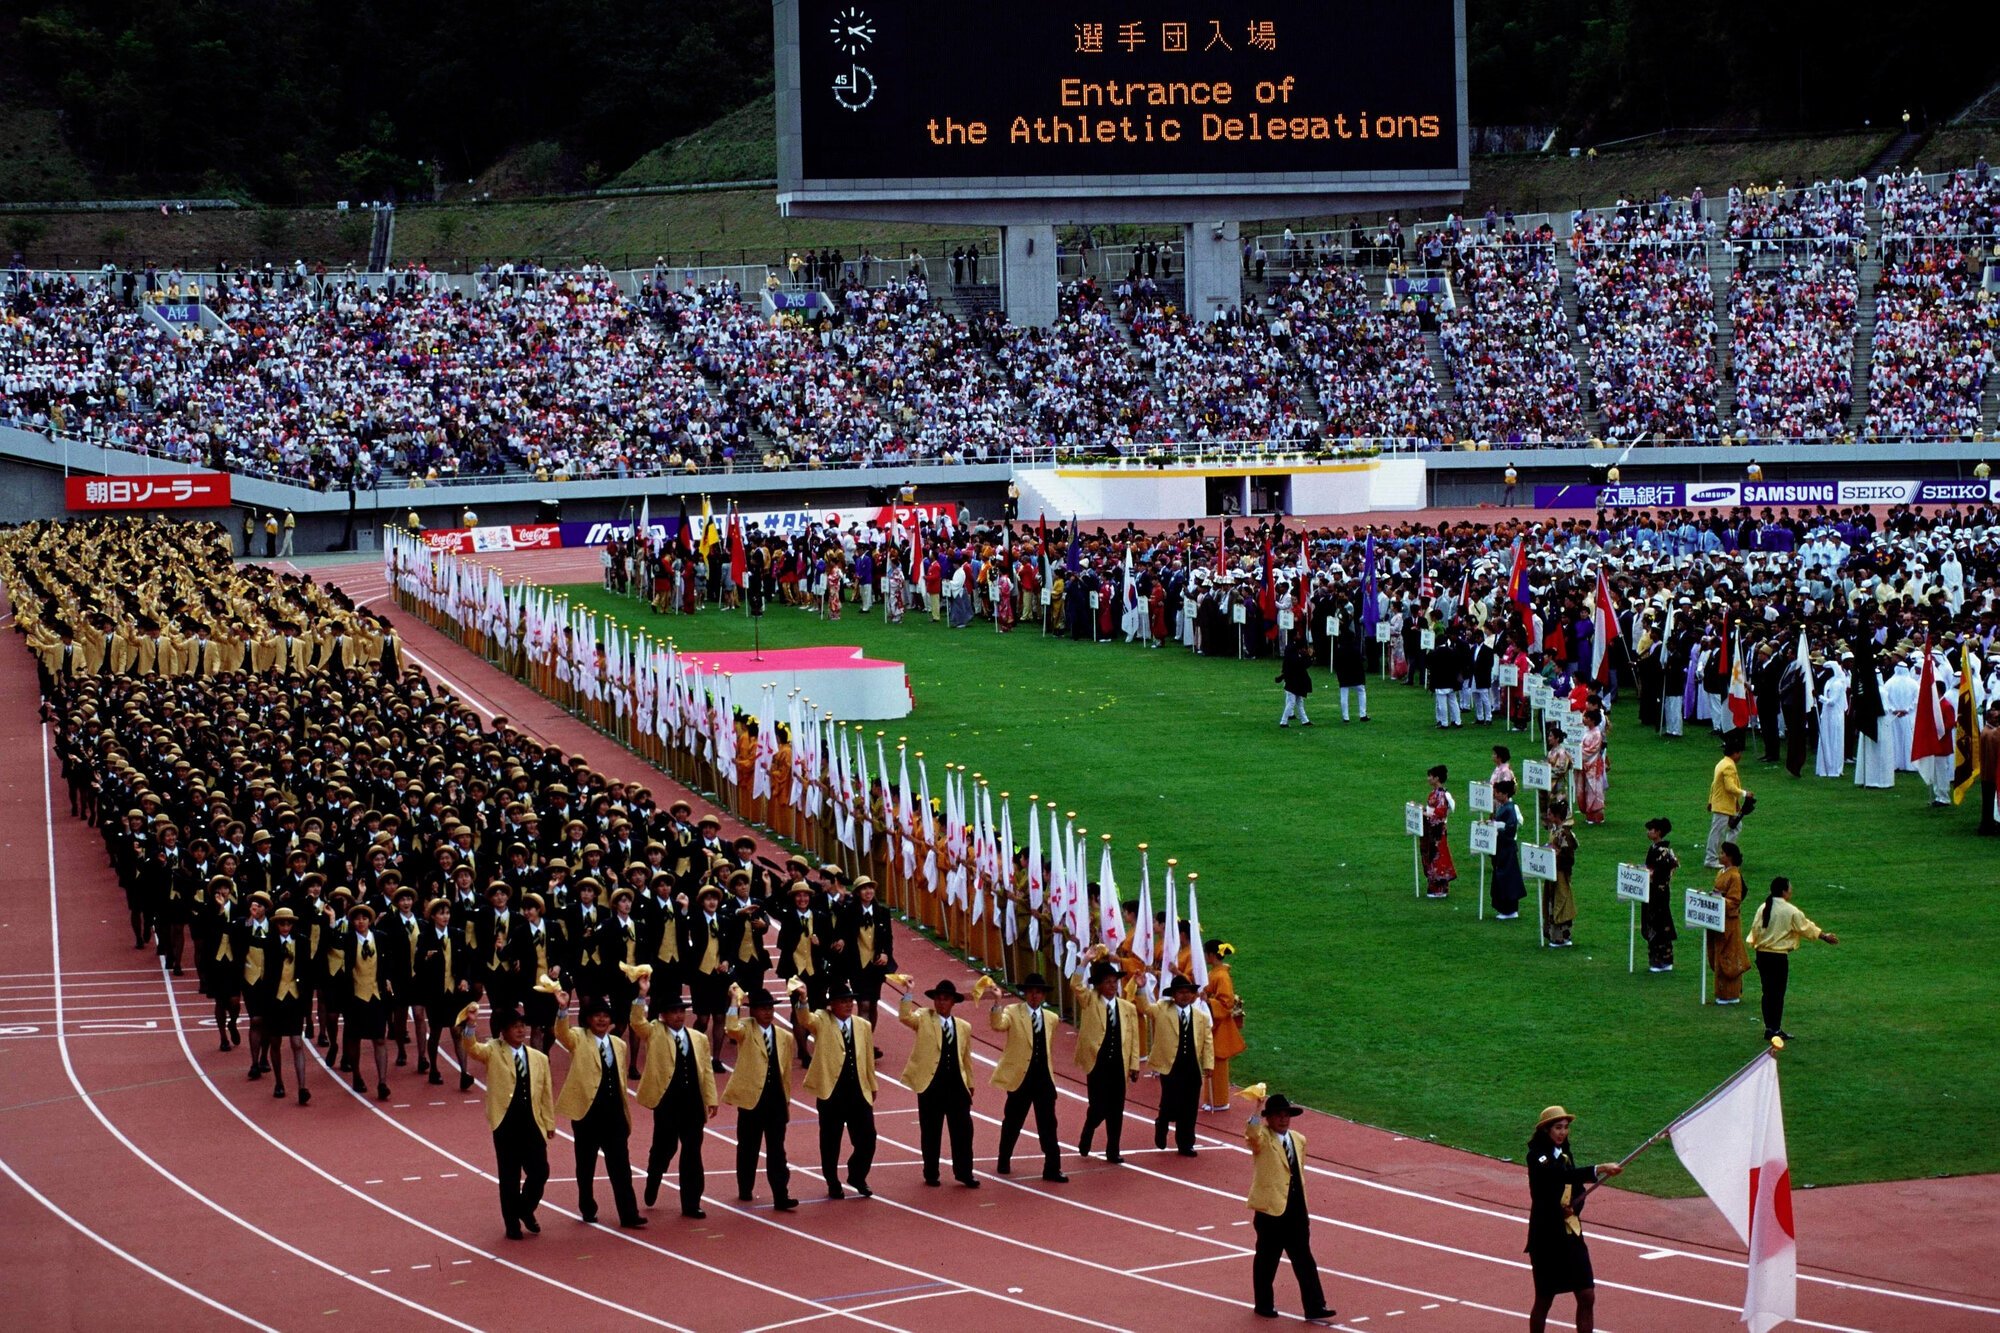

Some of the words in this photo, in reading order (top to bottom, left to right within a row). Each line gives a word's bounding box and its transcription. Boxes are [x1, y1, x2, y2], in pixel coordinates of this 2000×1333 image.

[1074, 20, 1276, 53] 選手団入場
[834, 74, 848, 85] 45
[1061, 78, 1232, 106] Entrance
[1255, 75, 1295, 104] of
[926, 116, 987, 145] the
[1010, 114, 1181, 144] Athletic
[1202, 111, 1440, 141] Delegations
[1408, 280, 1429, 292] A12
[785, 294, 806, 307] A13
[167, 307, 189, 320] A14
[86, 480, 211, 504] 朝日ソーラー
[1602, 485, 1676, 505] 広島銀行
[1696, 491, 1731, 499] SAMSUNG
[1743, 485, 1834, 502] SAMSUNG
[1842, 486, 1906, 499] SEIKO
[1922, 485, 1987, 499] SEIKO
[519, 528, 550, 542] Coca-Cola
